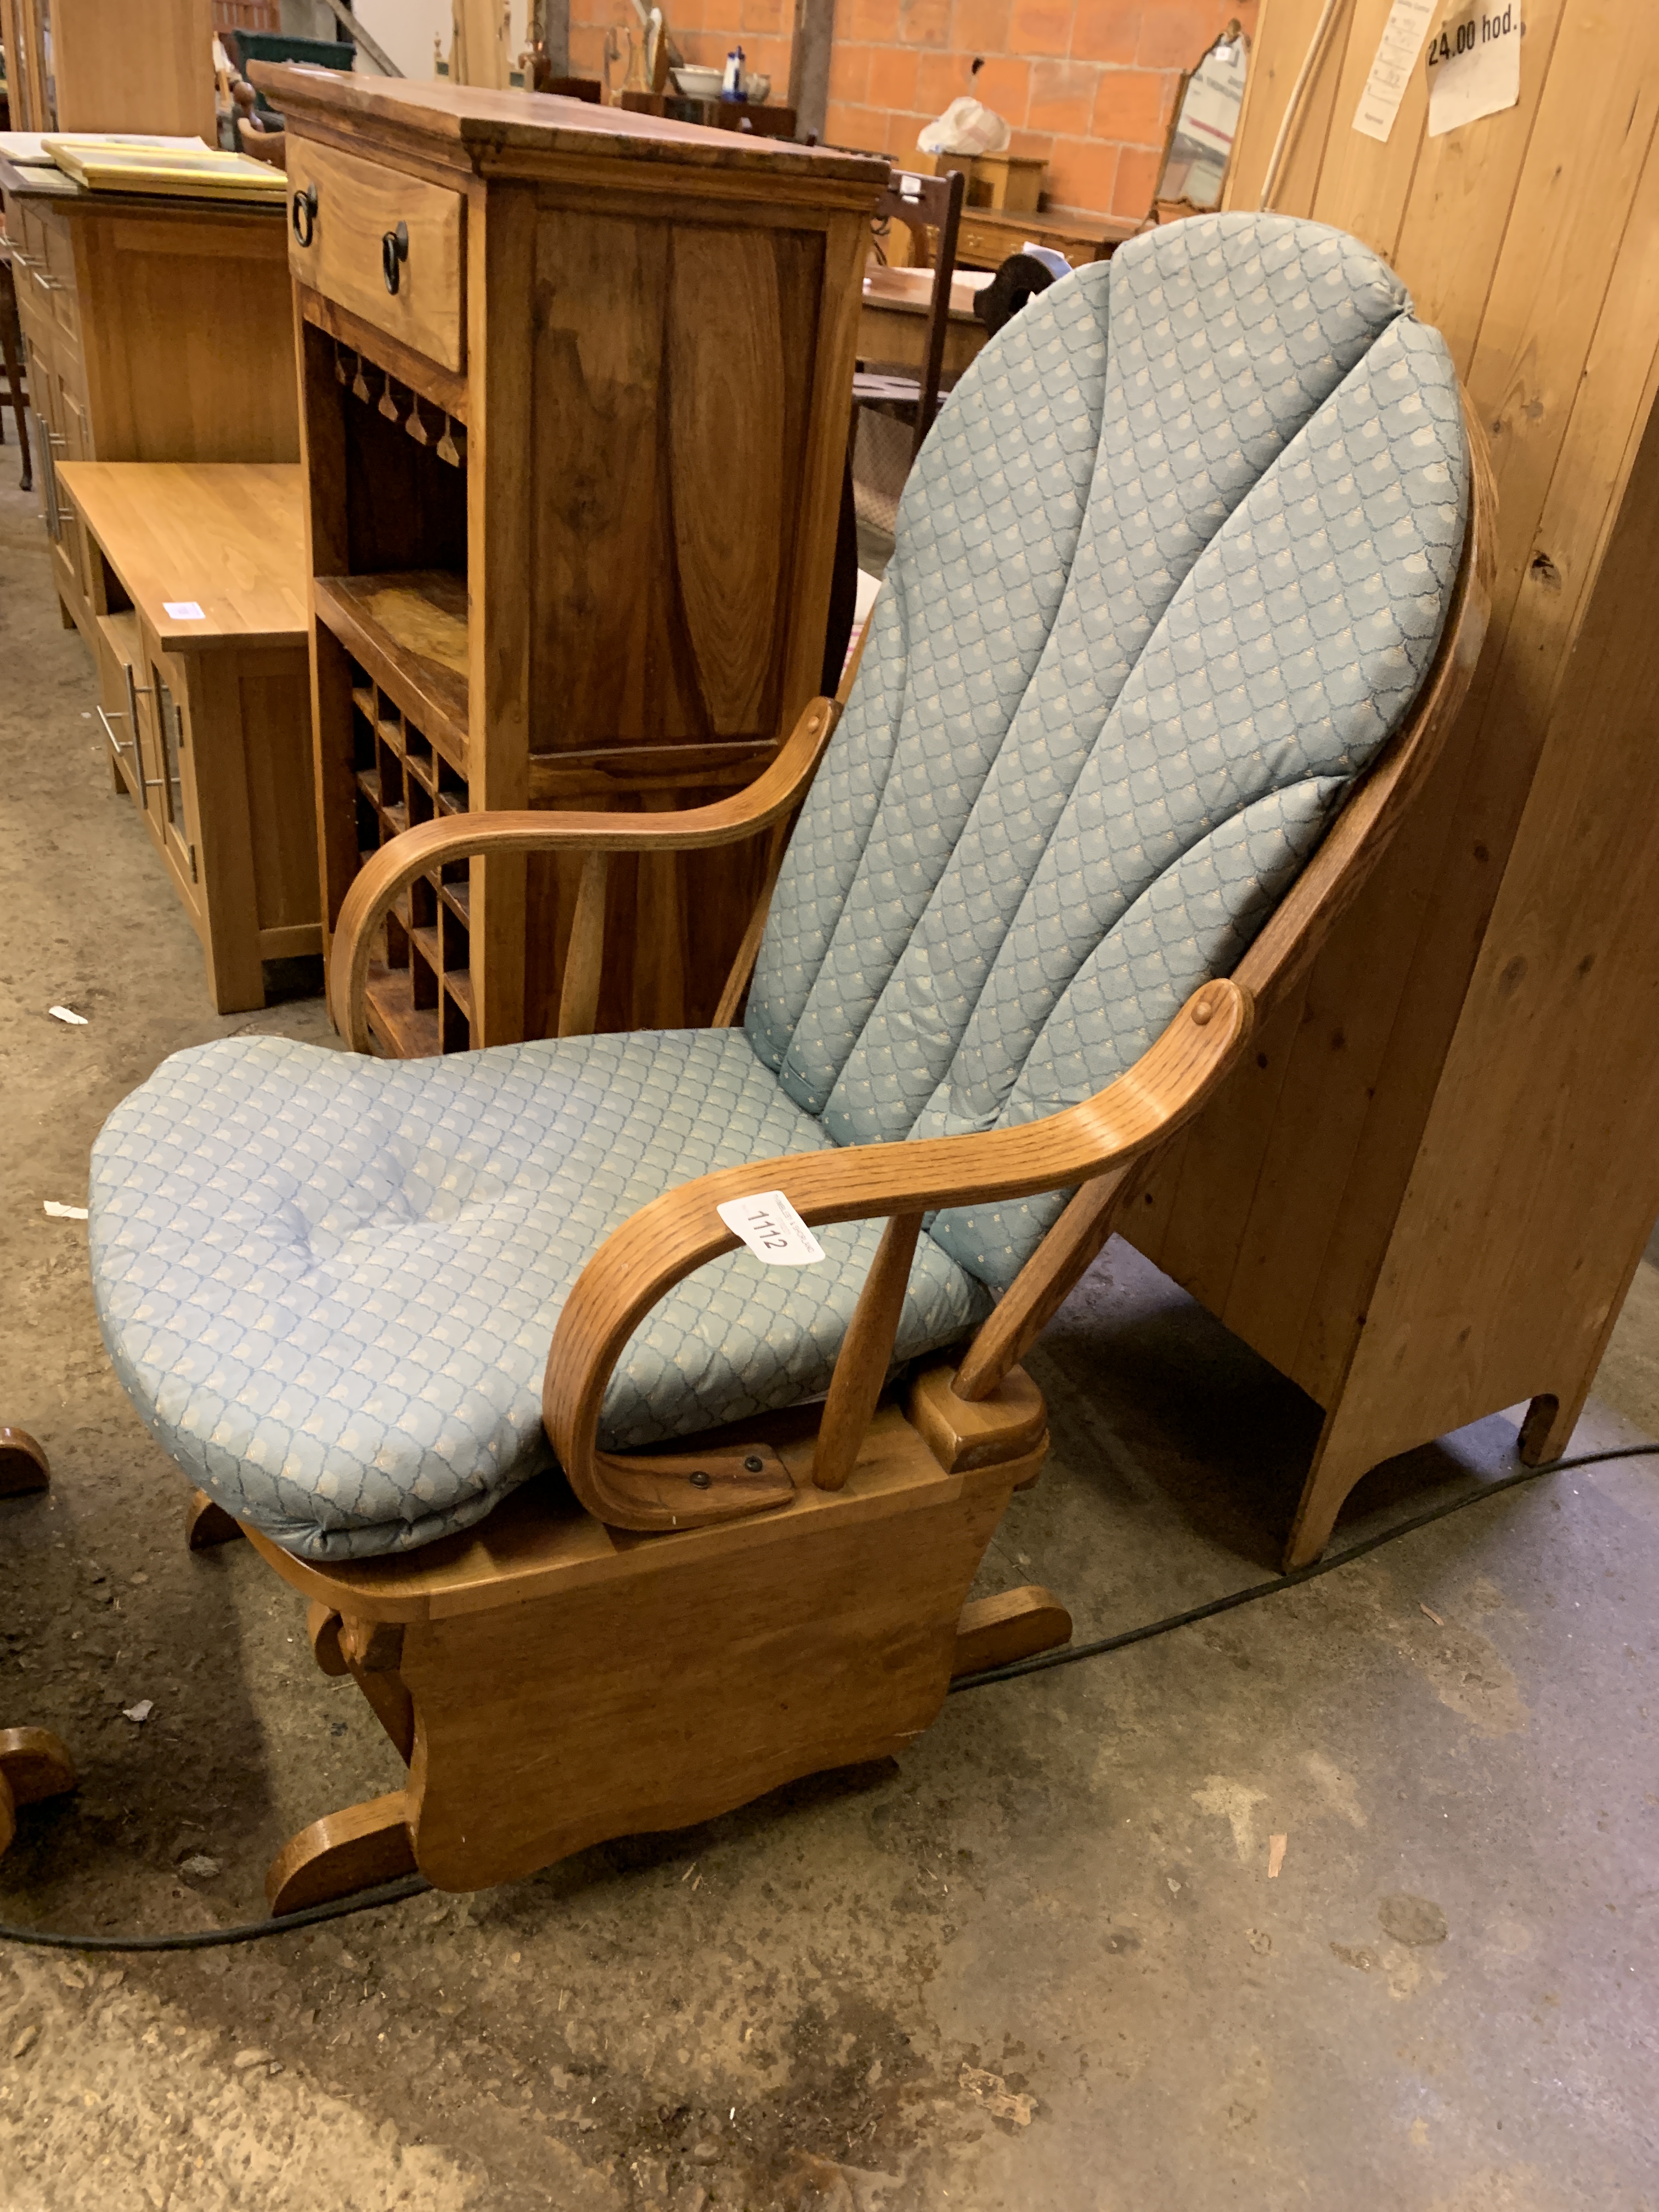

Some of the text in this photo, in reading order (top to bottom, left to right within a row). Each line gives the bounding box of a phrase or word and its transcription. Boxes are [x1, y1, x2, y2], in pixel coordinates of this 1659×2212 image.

[1429, 20, 1476, 66] 24.00
[1482, 3, 1517, 43] hod.
[748, 1210, 788, 1249] 1112
